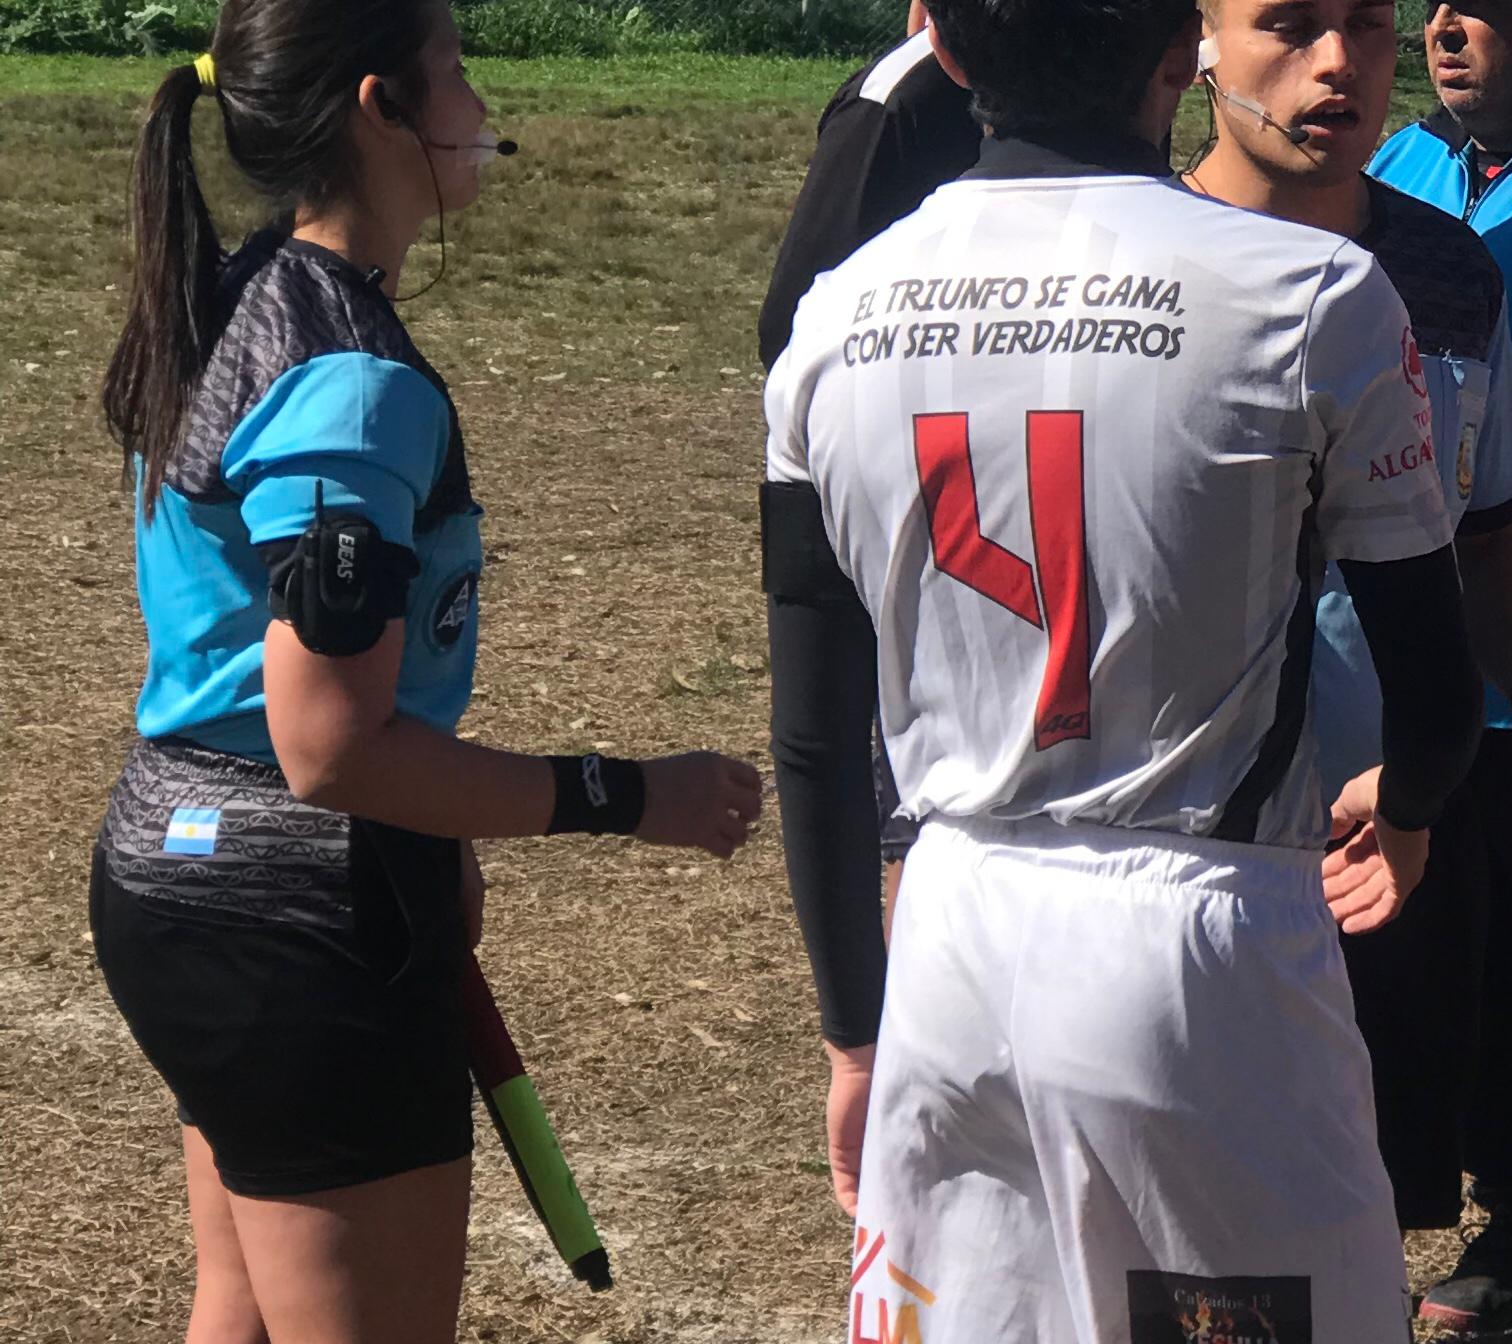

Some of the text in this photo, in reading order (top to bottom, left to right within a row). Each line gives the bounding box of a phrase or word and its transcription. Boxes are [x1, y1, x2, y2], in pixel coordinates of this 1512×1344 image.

[852, 273, 1186, 325] EL TRIUNFO SE GANA,
[843, 317, 1185, 368] CON SER VERDADEROS
[337, 533, 355, 579] EJEAS
[911, 409, 1092, 752] 4
